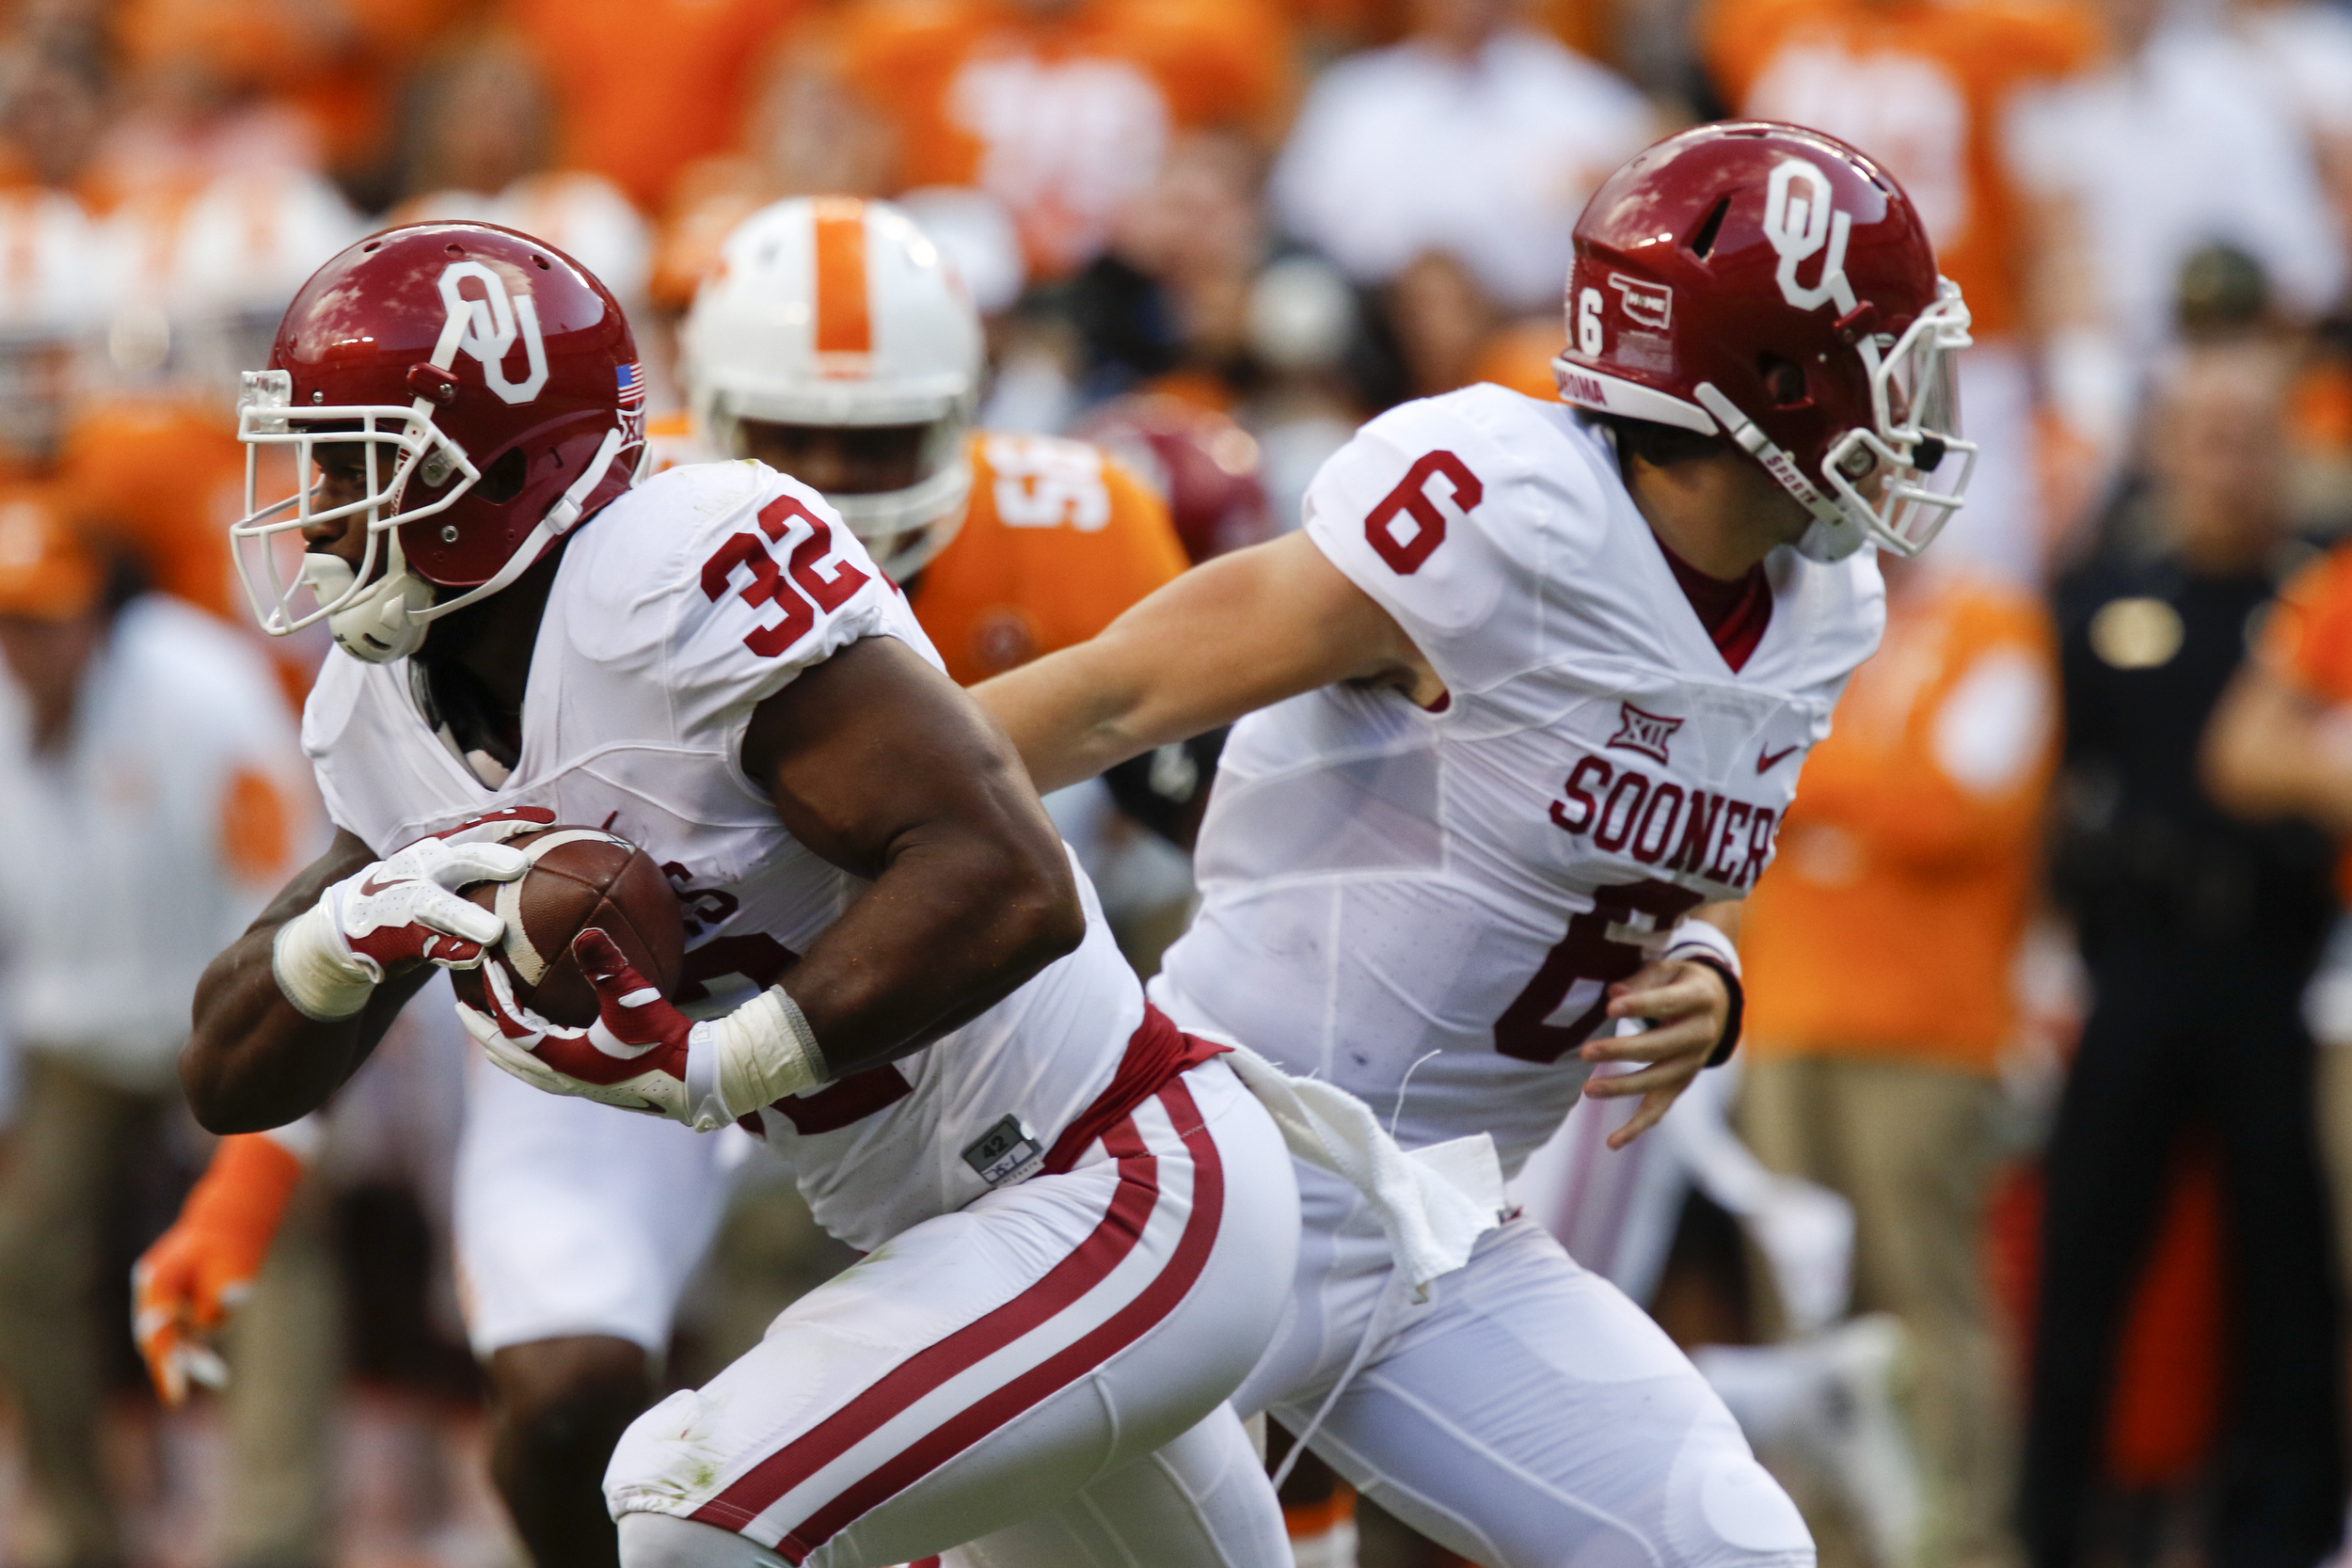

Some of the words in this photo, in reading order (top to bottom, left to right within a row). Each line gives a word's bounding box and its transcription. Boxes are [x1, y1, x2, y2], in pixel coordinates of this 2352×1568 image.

[1763, 159, 1851, 310] OU
[437, 261, 549, 405] OU
[1579, 287, 1603, 356] 6
[700, 495, 870, 657] 32
[1365, 450, 1484, 576] 6
[1549, 755, 1788, 888] SOONER
[1494, 879, 1705, 1064] 6
[982, 1135, 1009, 1159] 42
